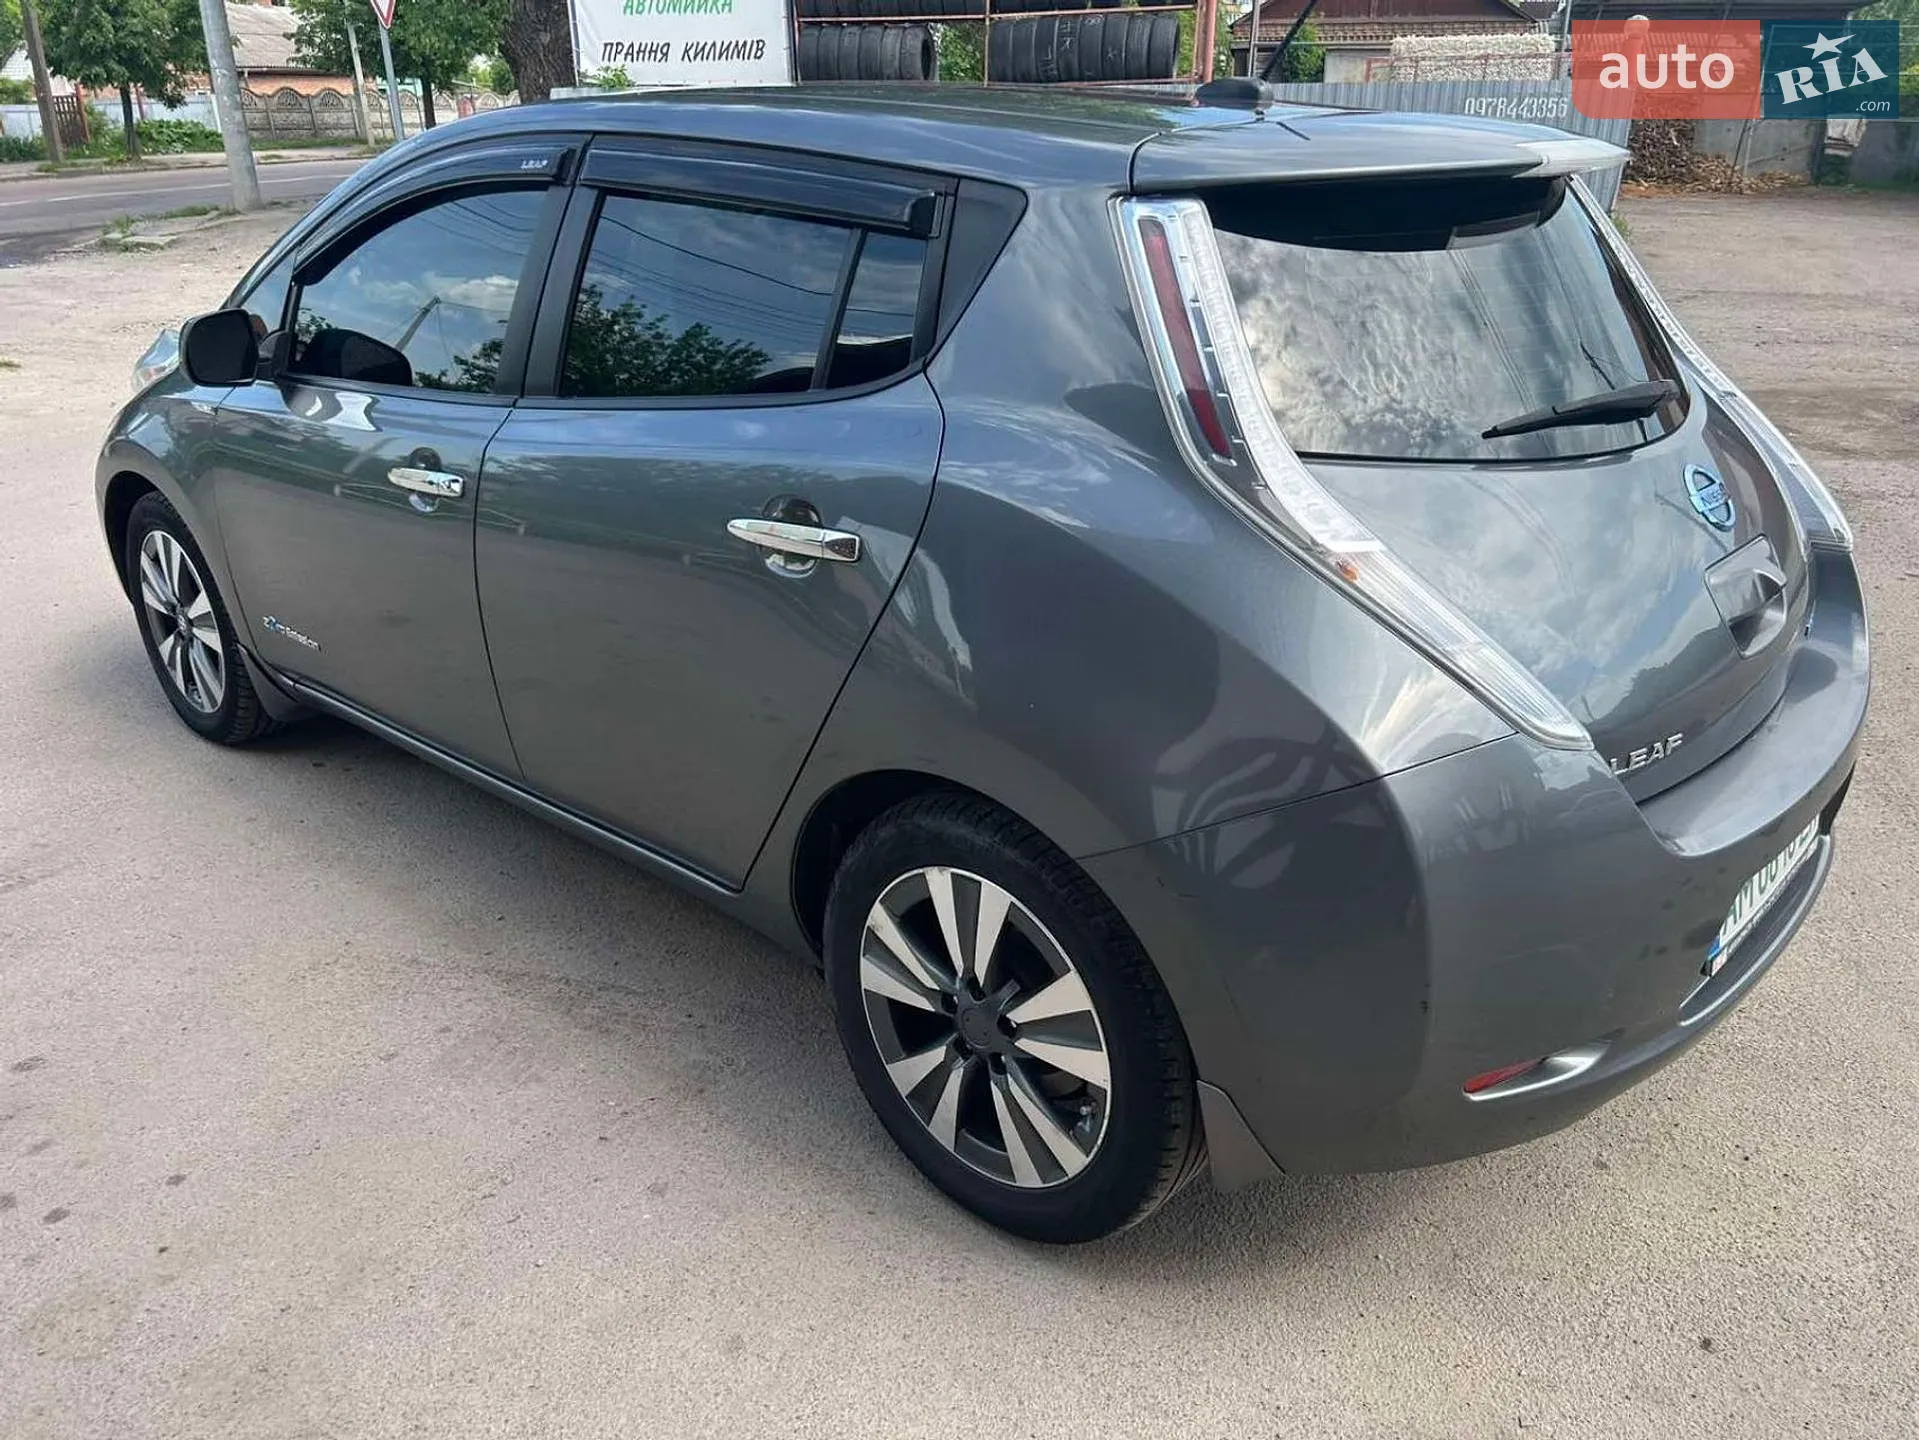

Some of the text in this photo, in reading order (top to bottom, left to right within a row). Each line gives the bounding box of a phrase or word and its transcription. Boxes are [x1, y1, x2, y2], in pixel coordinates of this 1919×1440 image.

[601, 39, 766, 63] ПРАННЯ КИЛИМІВ
[1610, 733, 1684, 776] LEAF
